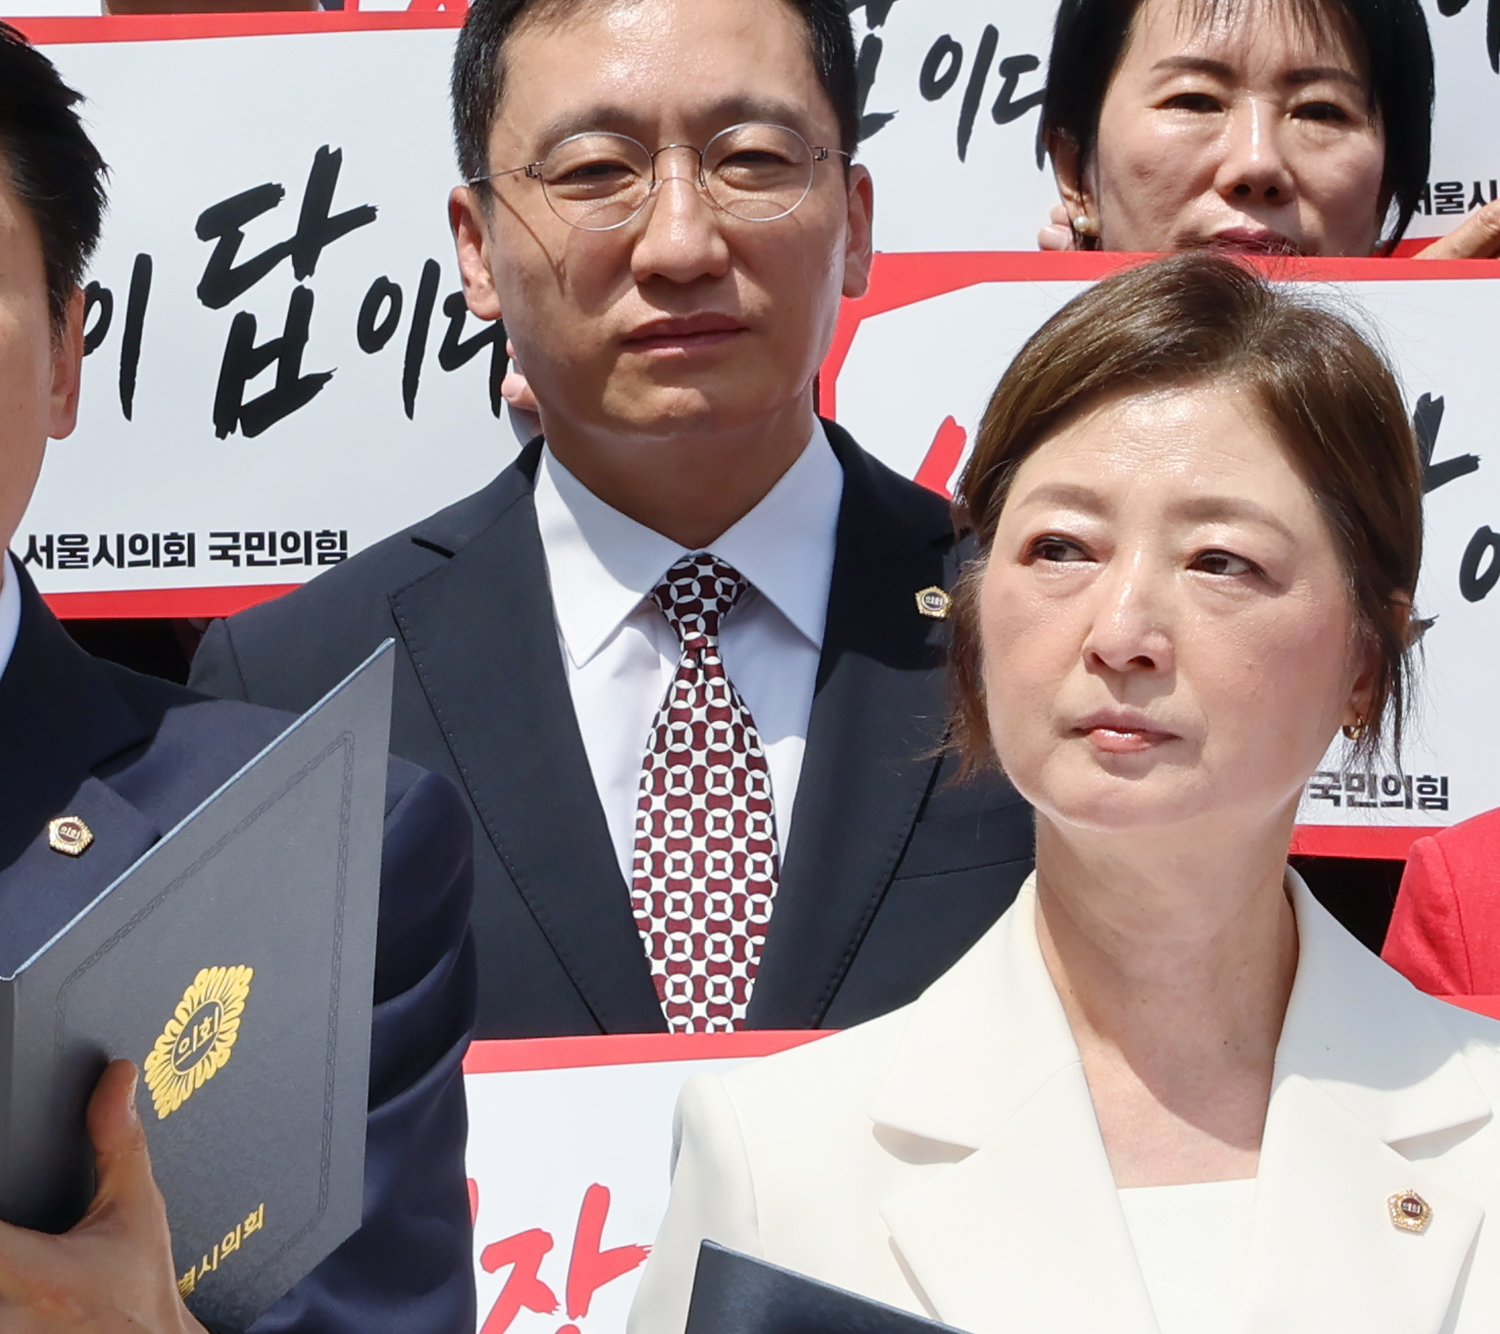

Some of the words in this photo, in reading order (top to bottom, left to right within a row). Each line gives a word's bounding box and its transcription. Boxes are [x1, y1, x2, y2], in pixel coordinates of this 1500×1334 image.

[23, 532, 196, 570] 서울시의회
[208, 529, 348, 568] 국민의힘
[1309, 771, 1449, 811] 국민의힘
[174, 1006, 221, 1067] 의회
